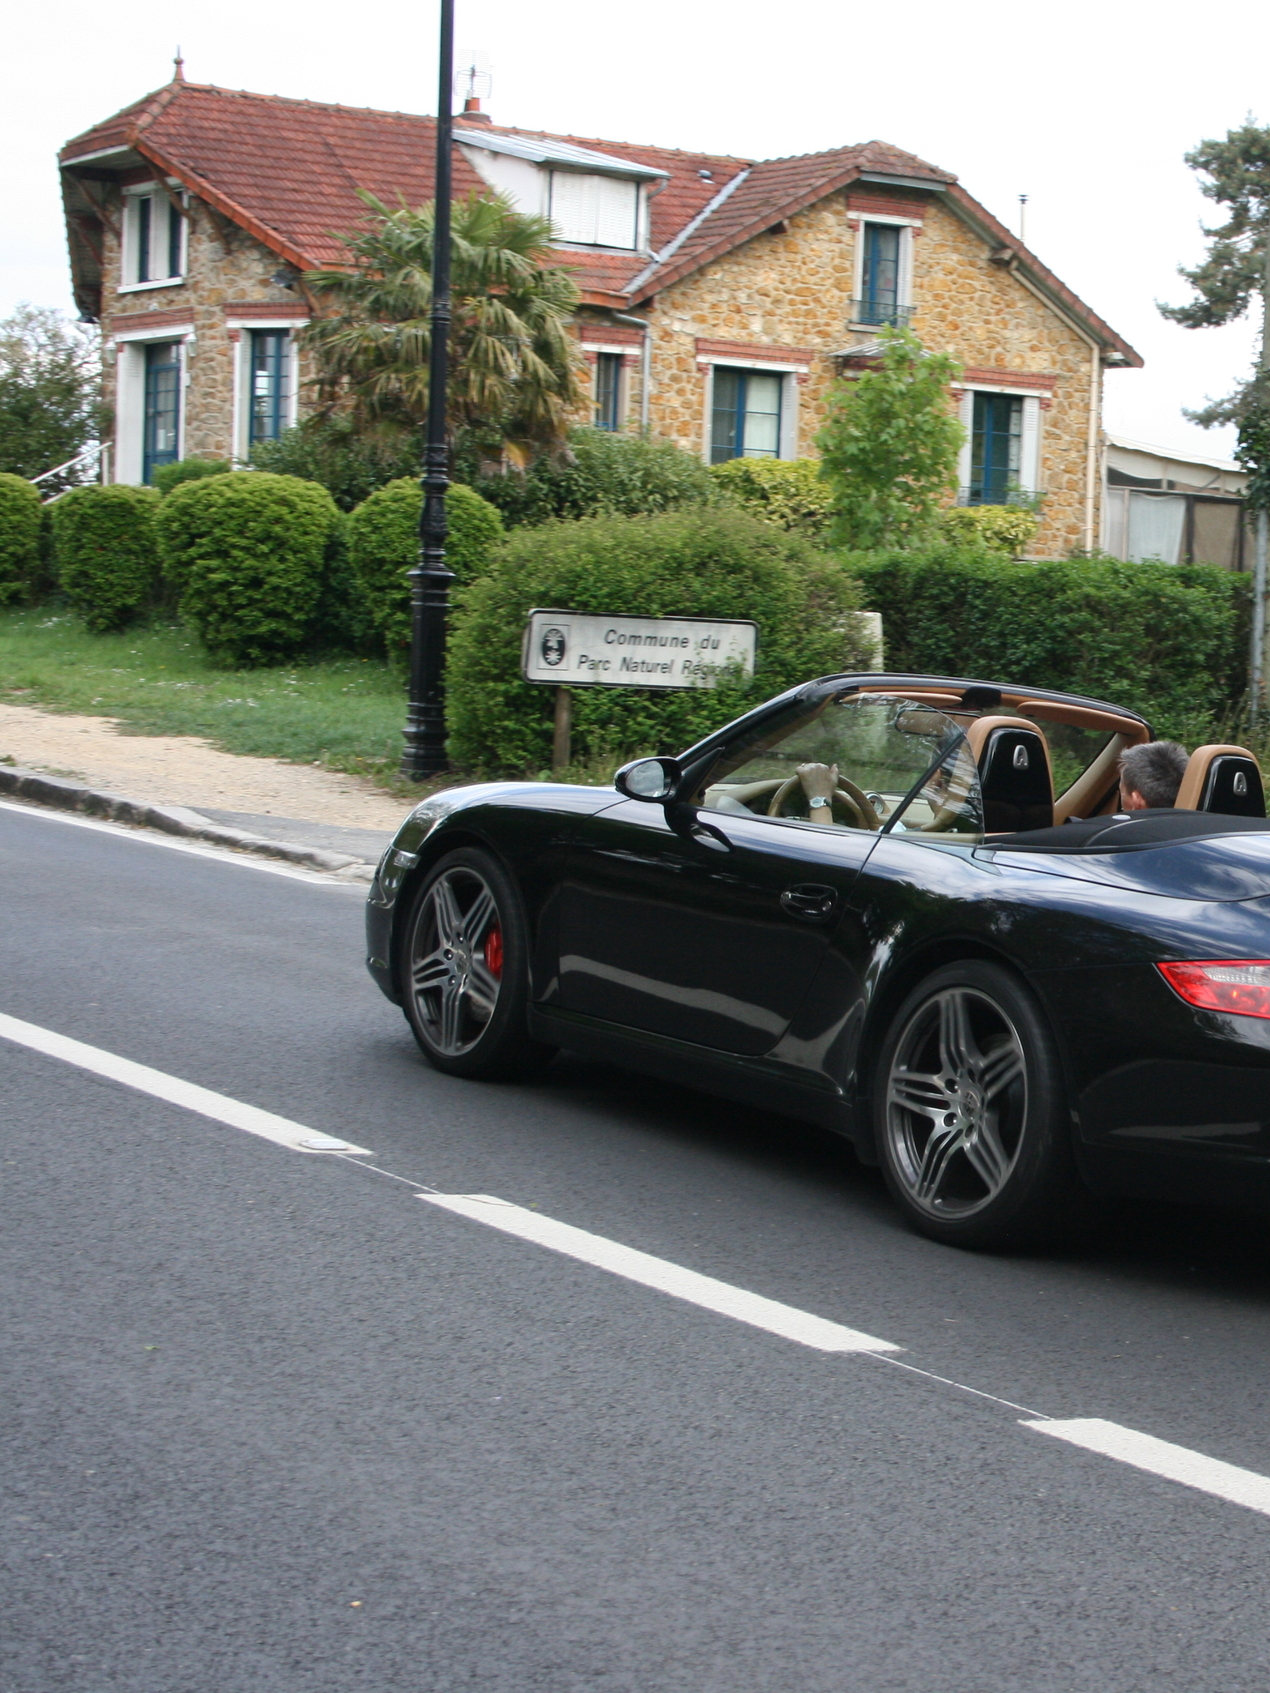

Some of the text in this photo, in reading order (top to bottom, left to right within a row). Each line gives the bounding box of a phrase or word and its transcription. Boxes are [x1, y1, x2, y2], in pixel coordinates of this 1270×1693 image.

[604, 629, 721, 650] Commune du
[577, 654, 611, 671] Parc
[619, 656, 674, 674] Naturel
